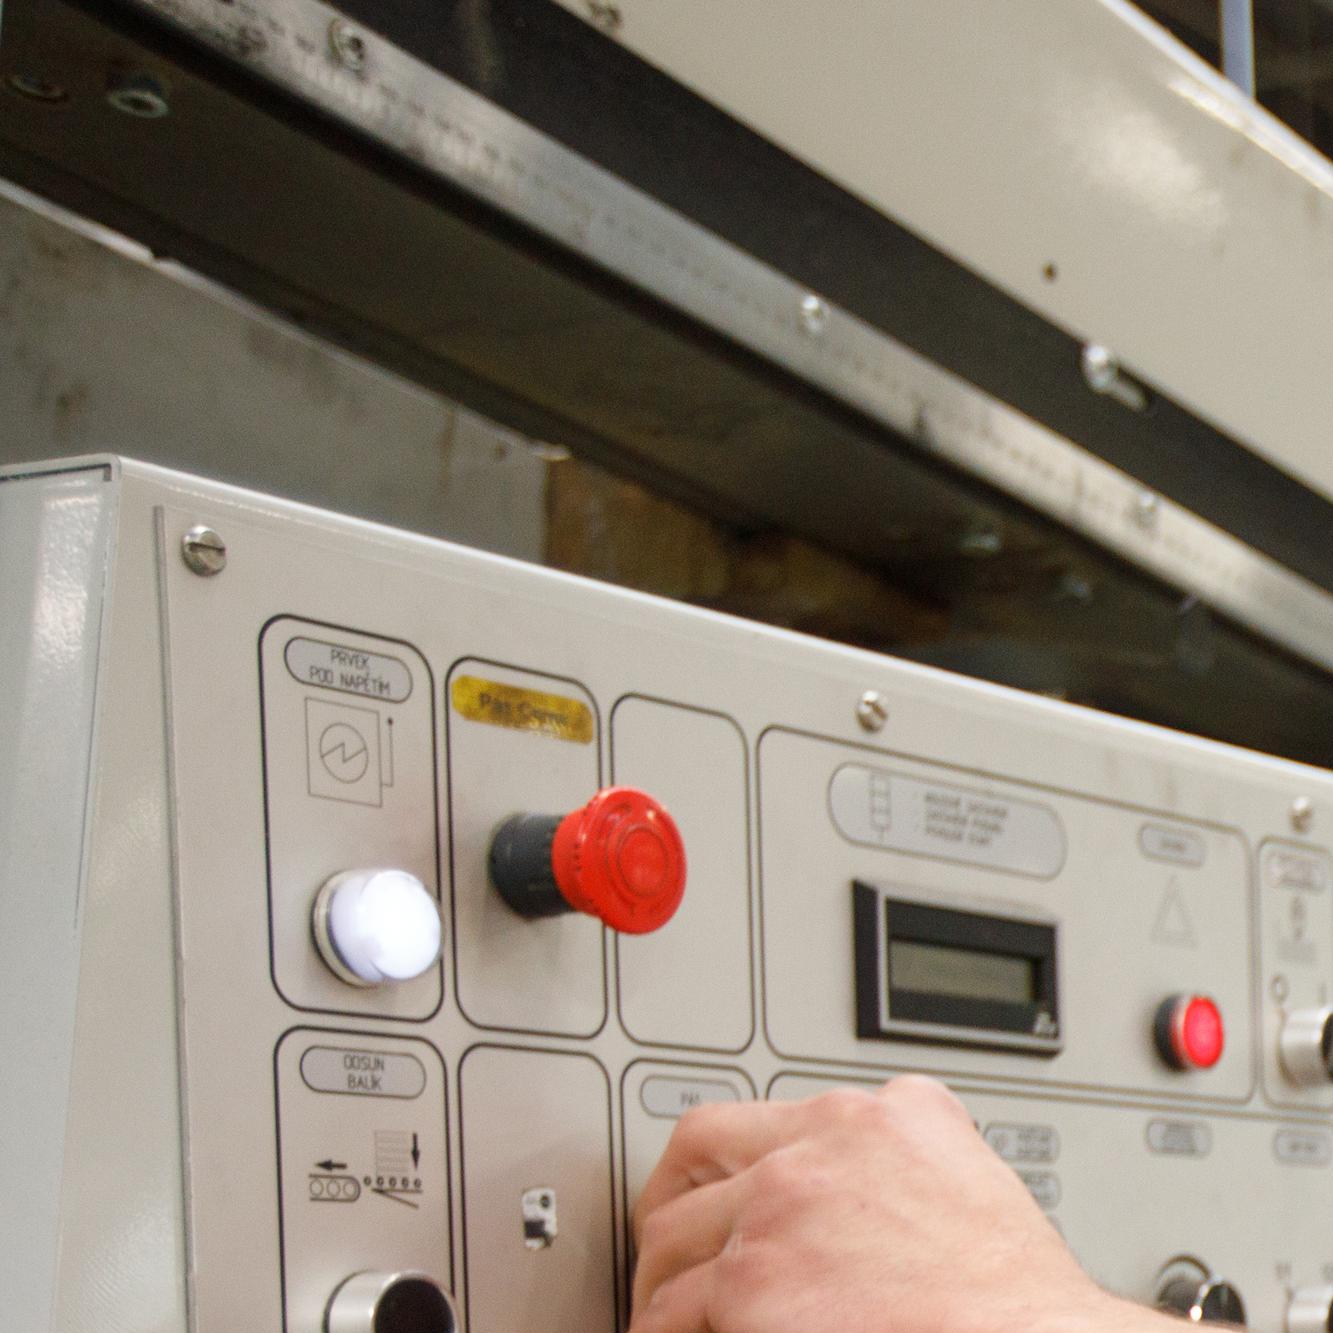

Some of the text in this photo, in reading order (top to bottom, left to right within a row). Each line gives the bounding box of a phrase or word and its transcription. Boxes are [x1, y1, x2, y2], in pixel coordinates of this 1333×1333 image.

[330, 648, 370, 670] PRVEK
[309, 665, 334, 684] POD
[343, 1054, 385, 1071] ODSUN
